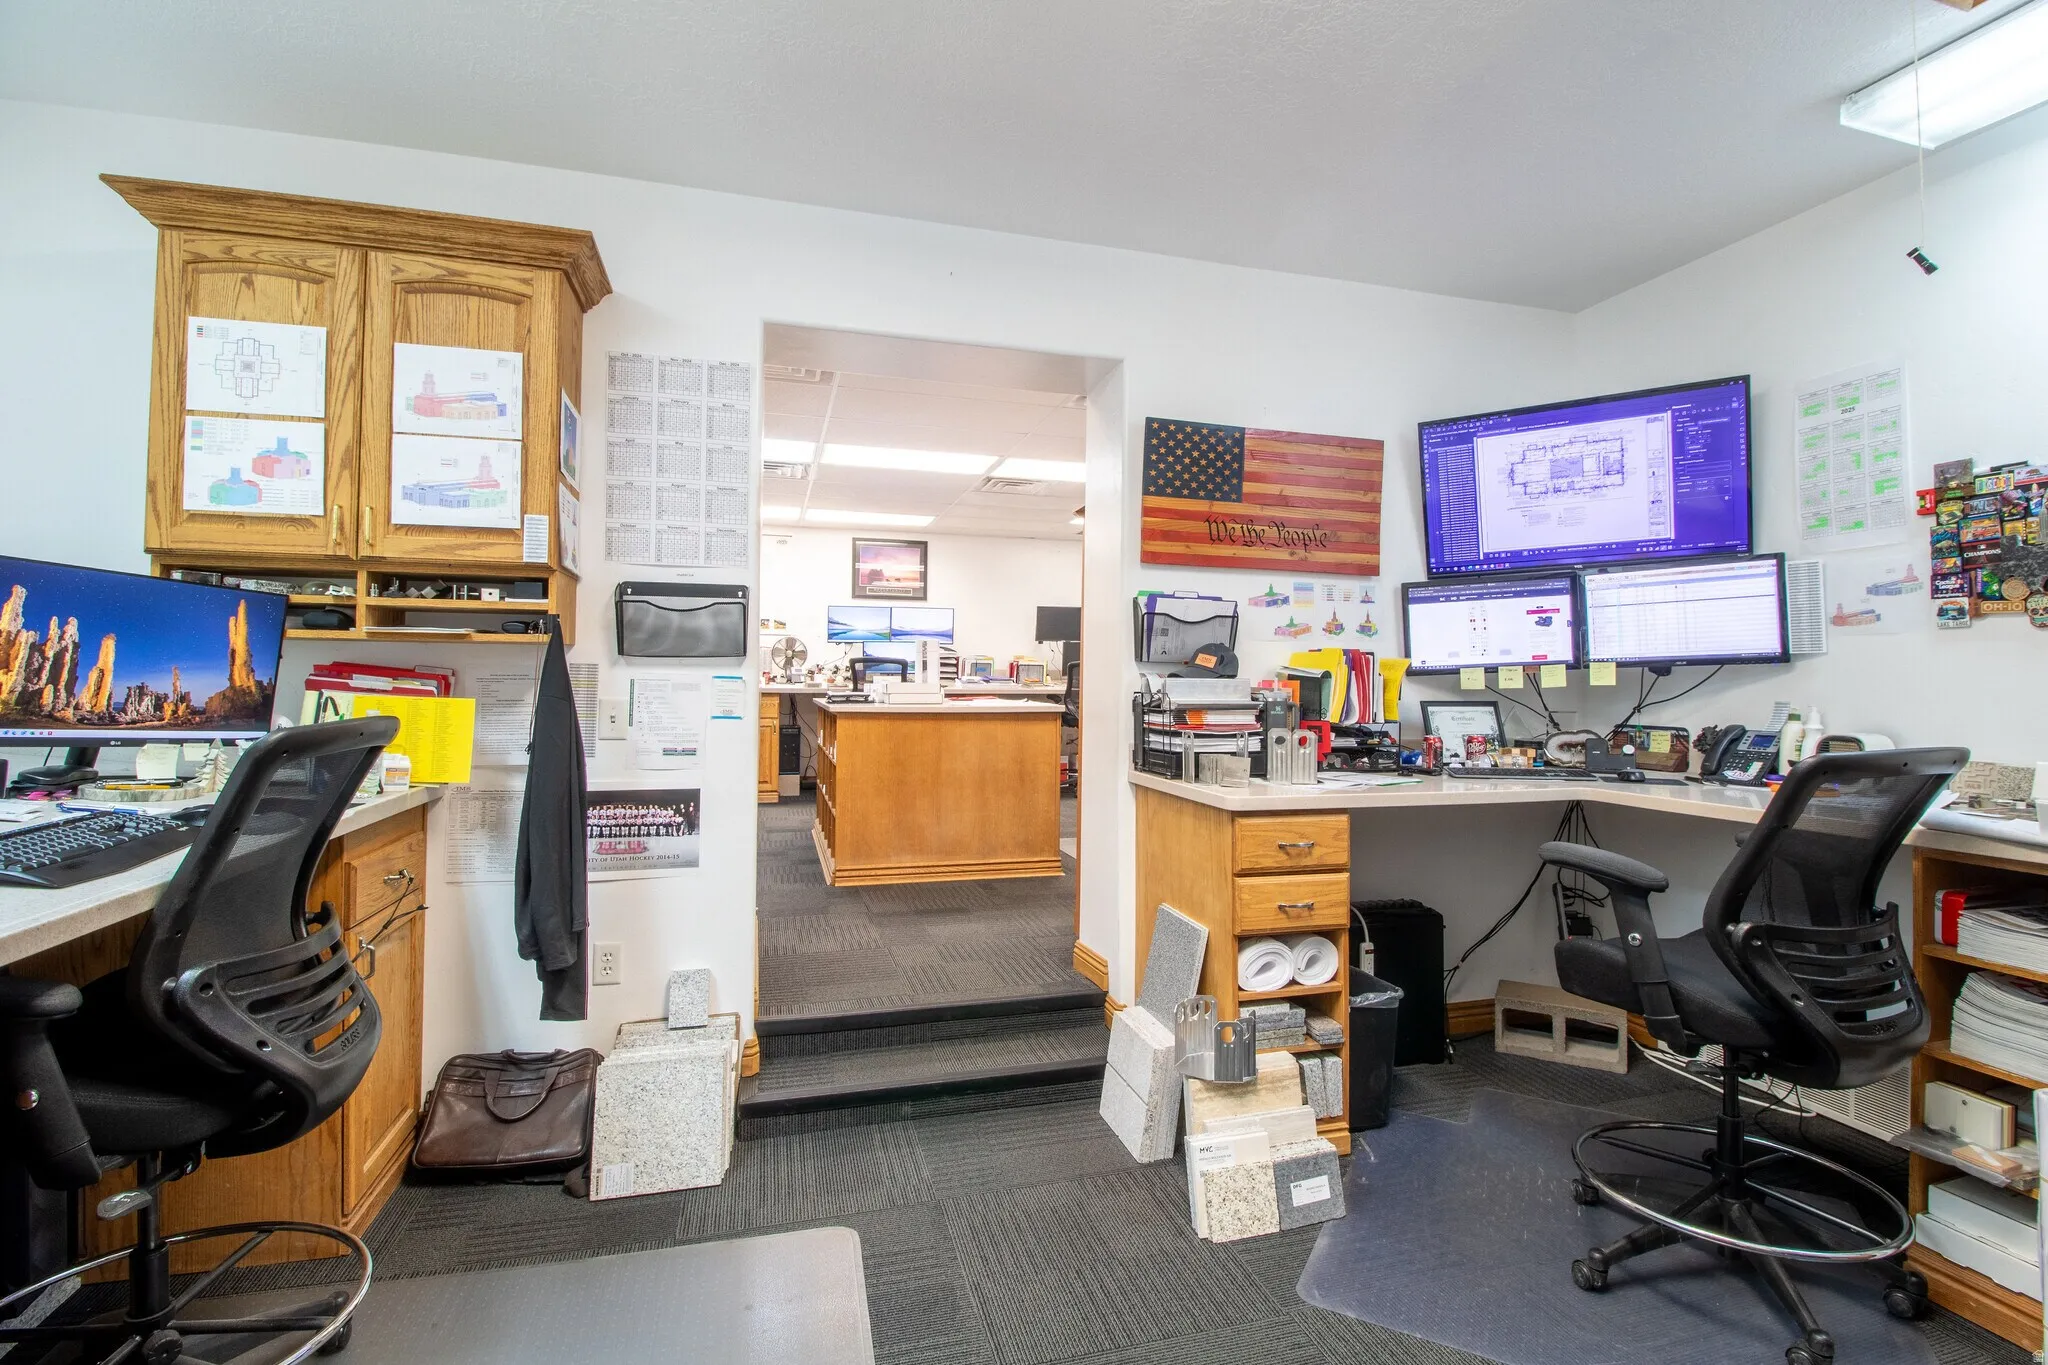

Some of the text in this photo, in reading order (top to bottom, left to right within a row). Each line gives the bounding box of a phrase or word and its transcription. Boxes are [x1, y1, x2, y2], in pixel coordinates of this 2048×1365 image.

[1840, 406, 1856, 415] 2025
[1203, 515, 1239, 546] We
[1265, 521, 1327, 553] People
[1983, 602, 2022, 611] OH-IO
